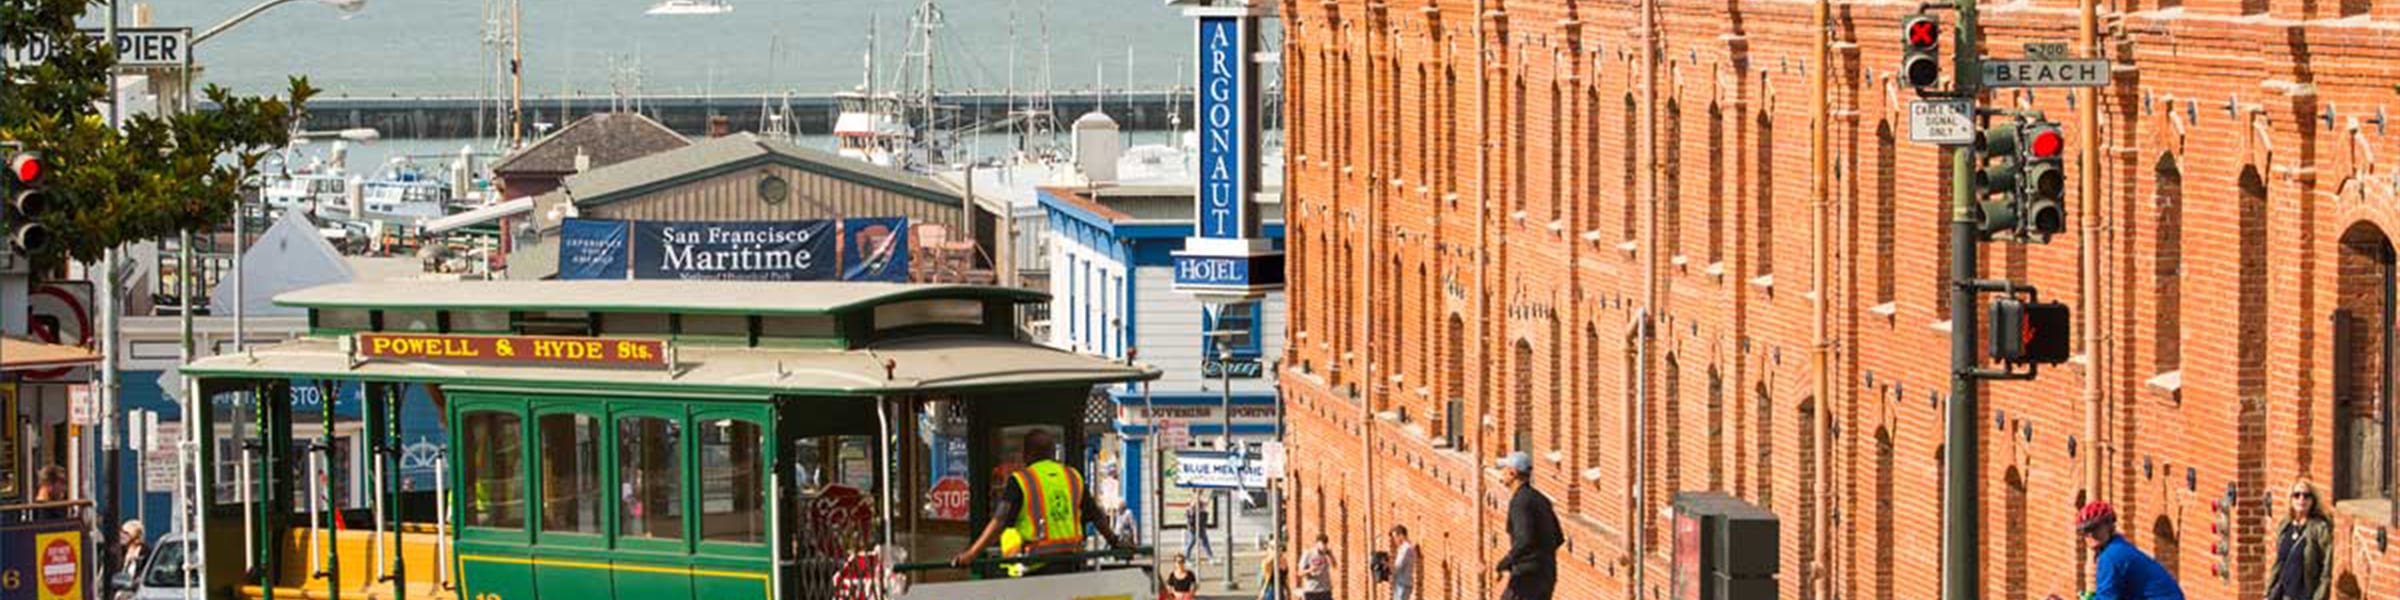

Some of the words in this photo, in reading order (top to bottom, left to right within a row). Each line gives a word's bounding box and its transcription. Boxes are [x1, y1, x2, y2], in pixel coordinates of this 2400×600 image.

[117, 35, 177, 60] PIER
[1996, 64, 2096, 81] BEACH
[1210, 22, 1231, 235] ARGONAUT
[1925, 115, 1957, 126] SIGNAL
[1929, 126, 1953, 137] ONLY
[663, 227, 700, 244] San
[708, 227, 811, 244] Francisco
[661, 243, 812, 271] Maritime
[1181, 258, 1242, 281] HOTEL
[373, 337, 478, 357] POWELL
[495, 339, 514, 357] &
[533, 340, 603, 360] HYDE
[617, 341, 653, 359] Sts.
[1183, 463, 1210, 474] BLUE
[1213, 464, 1265, 476] MERAID
[3, 569, 20, 590] 6
